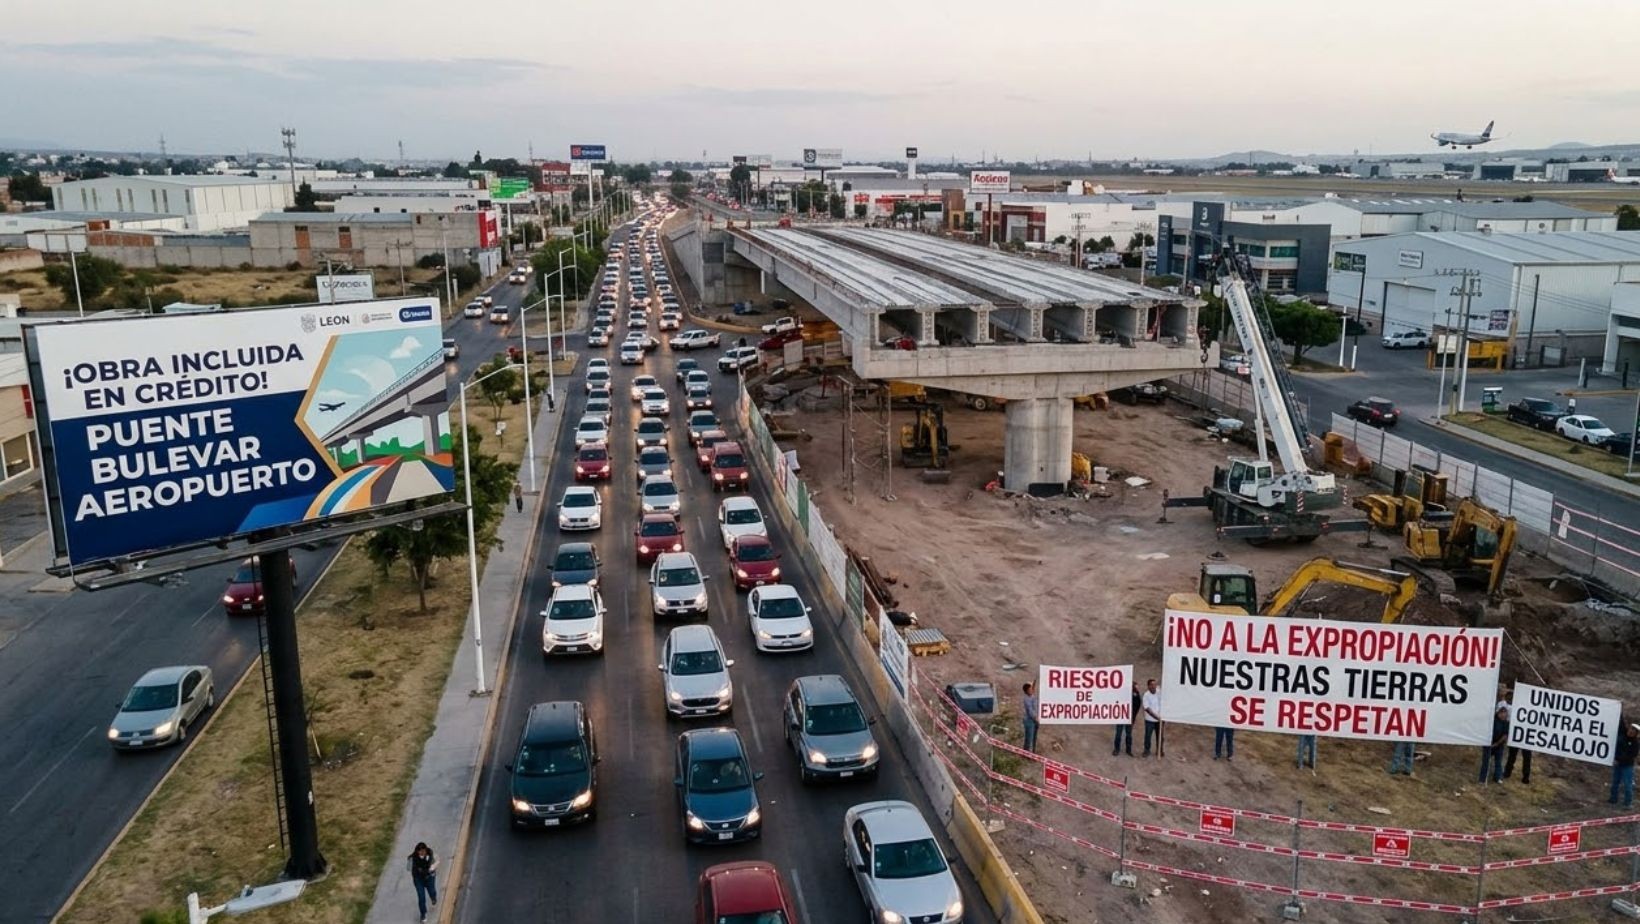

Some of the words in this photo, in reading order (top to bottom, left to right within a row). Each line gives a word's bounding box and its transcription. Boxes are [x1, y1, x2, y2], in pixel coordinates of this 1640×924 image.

[63, 357, 161, 389] ¡OBRA
[172, 343, 303, 374] INCLUIDA
[85, 388, 124, 410] EN
[135, 372, 268, 404] CRÉDITO!
[86, 407, 234, 451] PUENTE
[91, 436, 260, 484] BULEVAR
[74, 457, 316, 522] AEROPUERTO
[1168, 618, 1212, 650] ¡NO
[1220, 620, 1238, 652] A
[1246, 622, 1278, 655] LA
[1288, 626, 1497, 669] EXPROPIACIÓN!
[1048, 669, 1123, 690] RIESGO
[1076, 691, 1092, 702] DE
[1180, 656, 1330, 696] NUESTRAS
[1345, 668, 1468, 704] TIERRAS
[1040, 700, 1130, 720] EXPROPIACIÓN
[1230, 696, 1264, 726] SE
[1278, 699, 1426, 738] RESPETAN
[1516, 708, 1584, 734] CONTRA
[1589, 720, 1608, 738] EL
[1530, 690, 1600, 716] UNIDOS
[1512, 725, 1610, 758] DESALOJO
